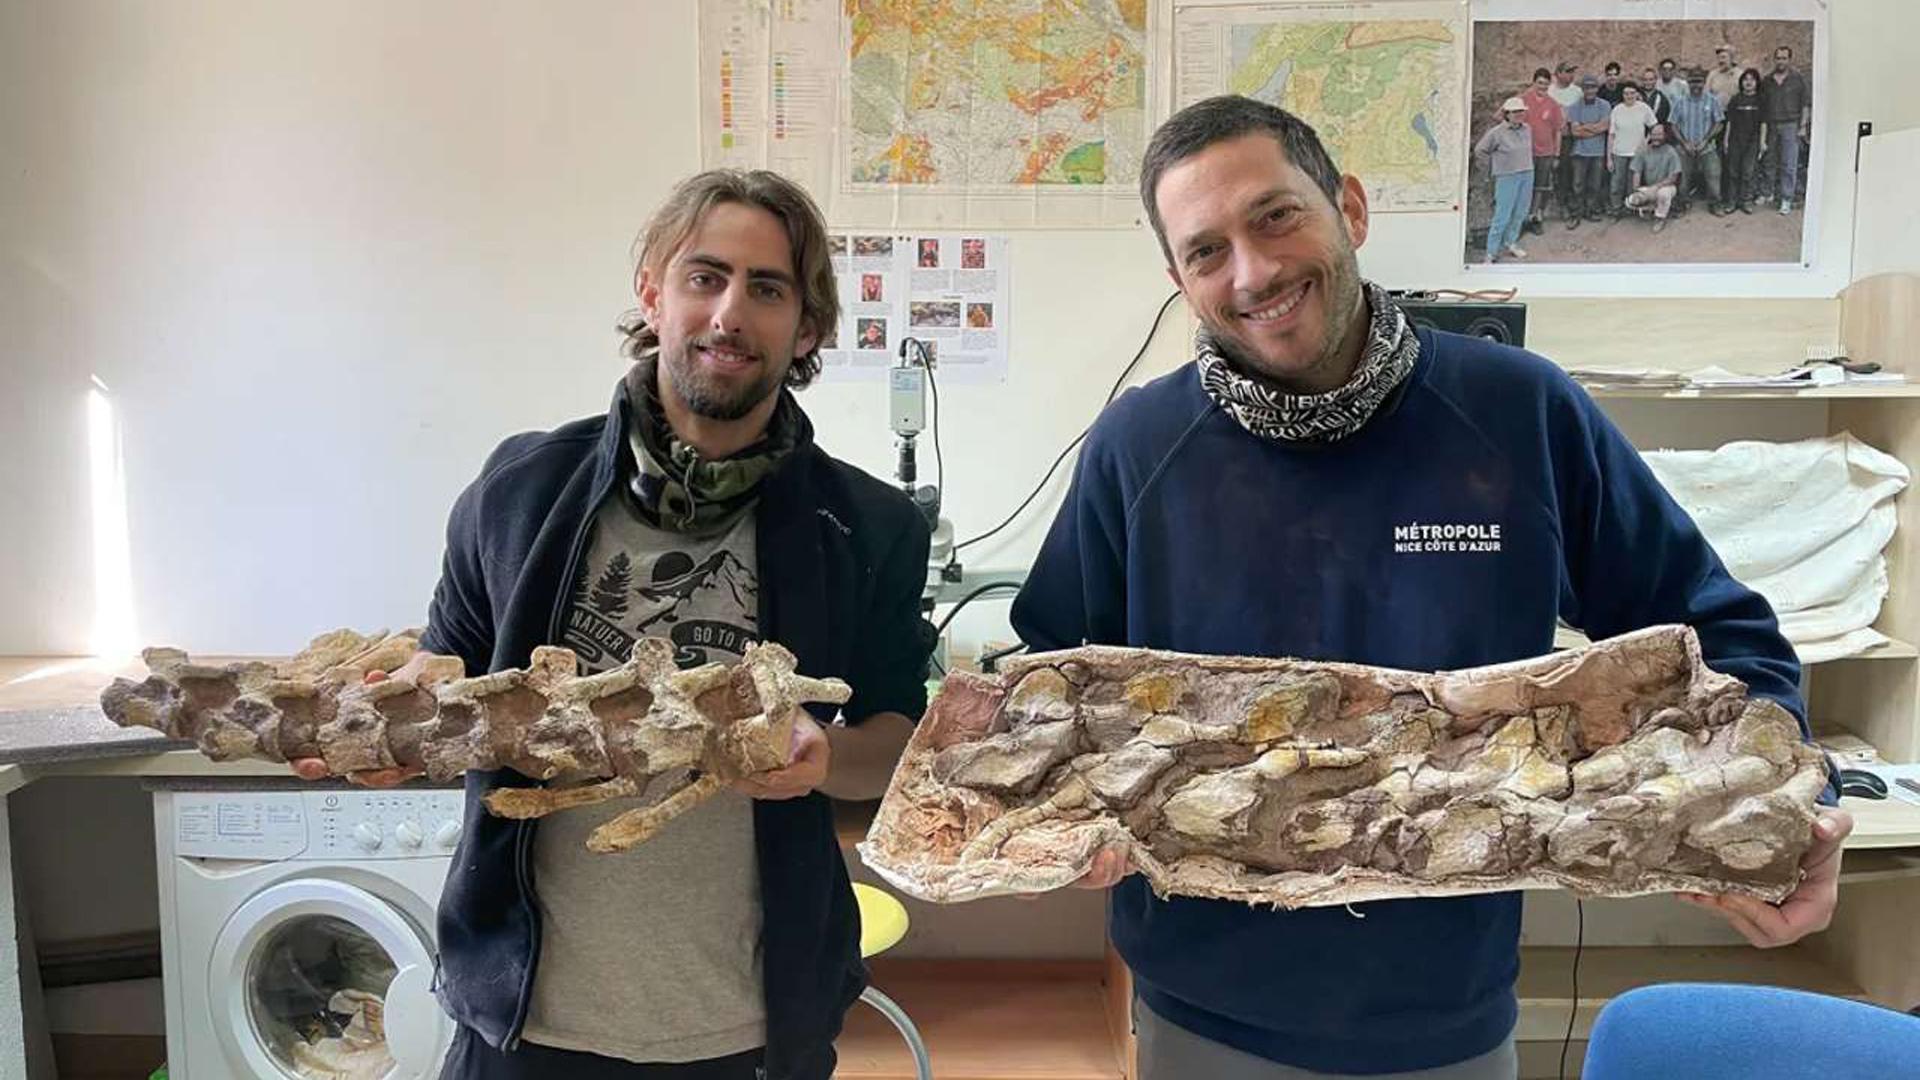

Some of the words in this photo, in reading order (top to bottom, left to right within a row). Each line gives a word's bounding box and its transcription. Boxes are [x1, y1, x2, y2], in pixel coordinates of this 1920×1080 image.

[1395, 521, 1501, 540] MÉTROPOLE
[1395, 542, 1422, 552] NICE
[1424, 539, 1456, 551] CÔTE
[1459, 541, 1501, 551] D'AZUR
[570, 609, 624, 651] NATUER
[694, 626, 712, 643] GO
[718, 628, 735, 647] TO
